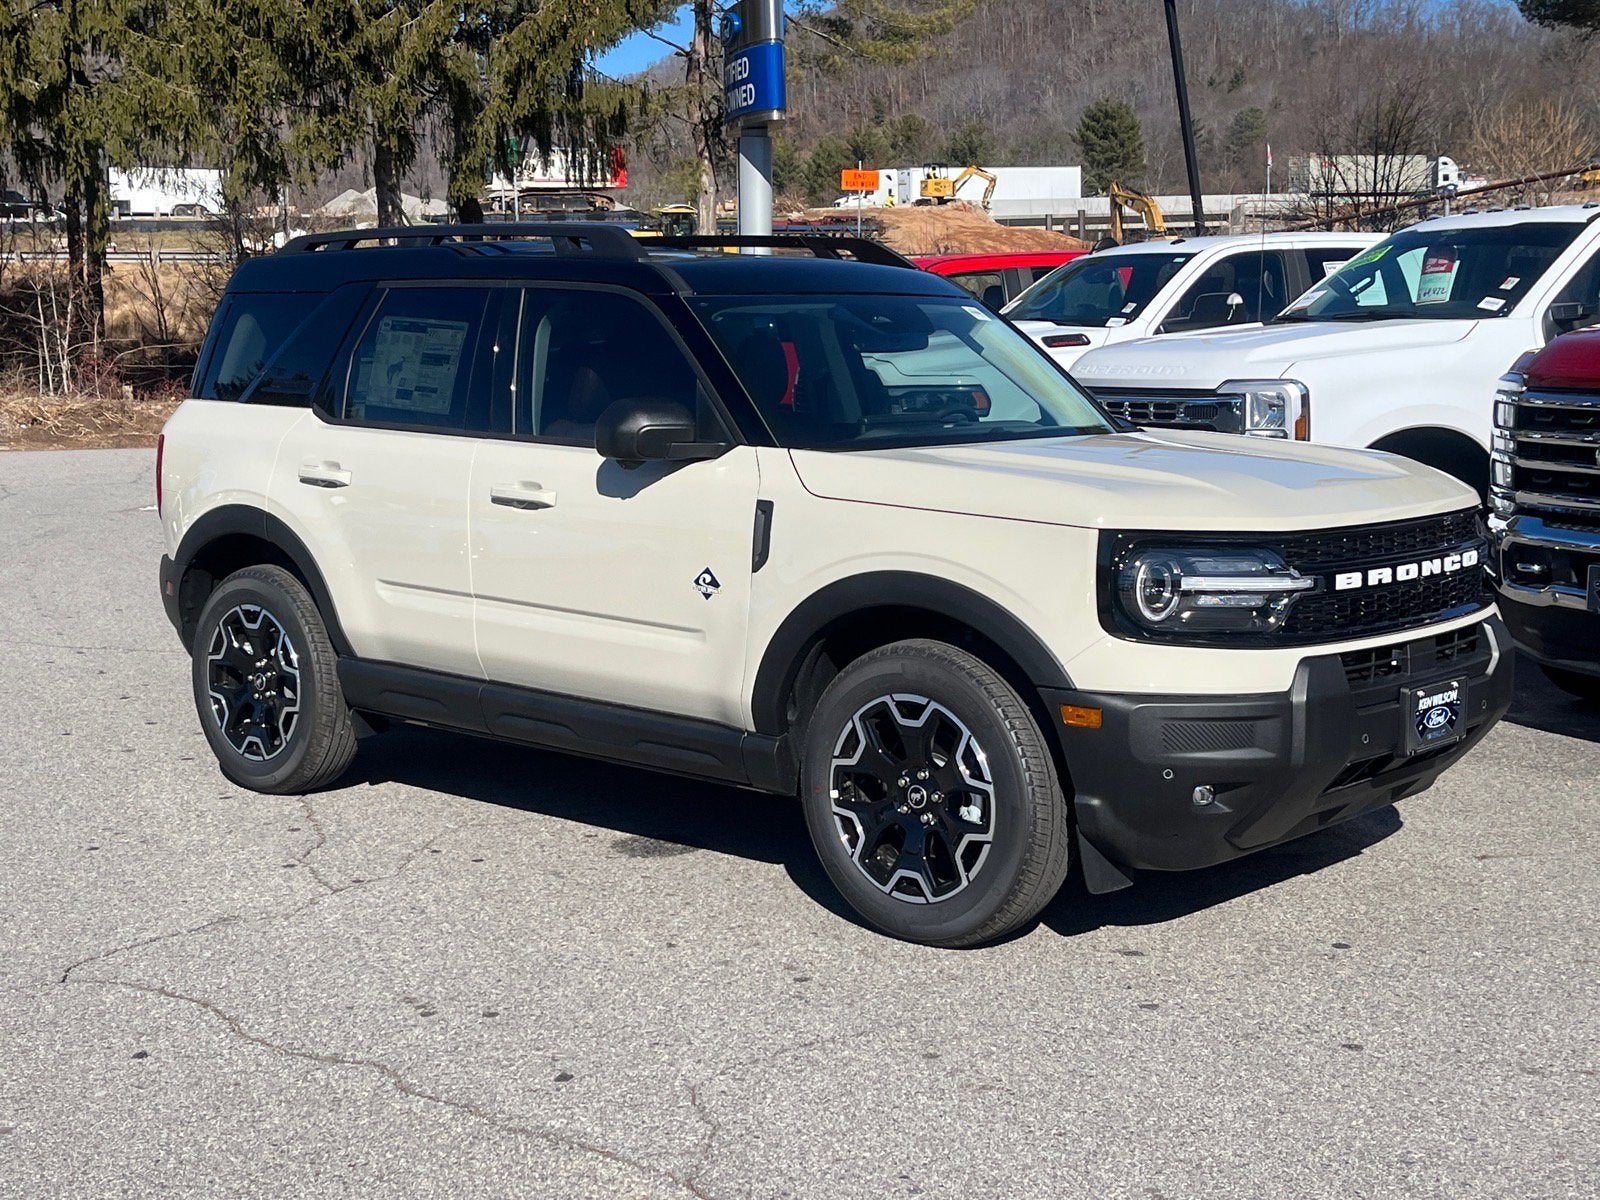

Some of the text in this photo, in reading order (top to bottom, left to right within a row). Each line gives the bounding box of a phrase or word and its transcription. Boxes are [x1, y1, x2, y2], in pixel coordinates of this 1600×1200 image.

[1075, 365, 1192, 375] SUPER DUTY
[1335, 550, 1478, 591] BRONCO
[1418, 689, 1458, 710] KEN WILSON
[1427, 708, 1448, 727] Ford
